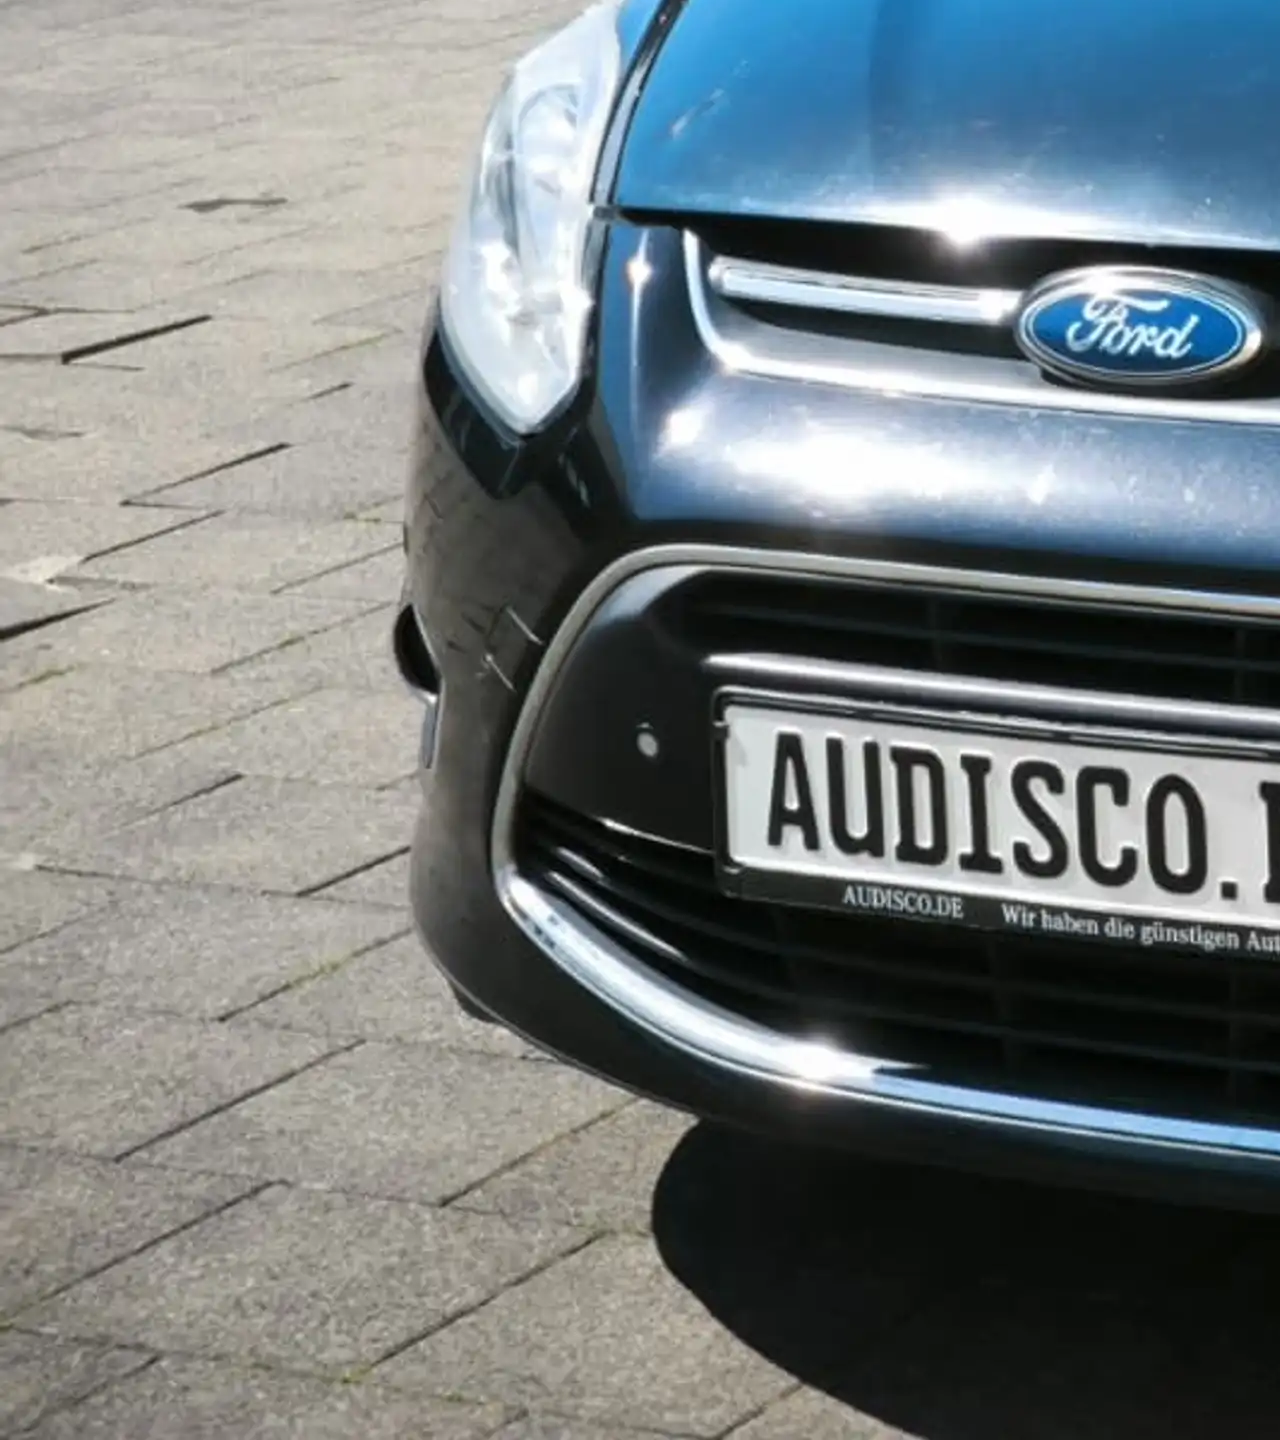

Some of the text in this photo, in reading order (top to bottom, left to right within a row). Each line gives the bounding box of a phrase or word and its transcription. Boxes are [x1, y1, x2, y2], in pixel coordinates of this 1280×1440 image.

[1066, 290, 1199, 358] Ford
[842, 886, 965, 920] AUDISCO.DE
[1001, 902, 1036, 928] Wir
[1041, 909, 1099, 936] haben
[1104, 920, 1135, 940] die
[1139, 923, 1240, 951] günstigen
